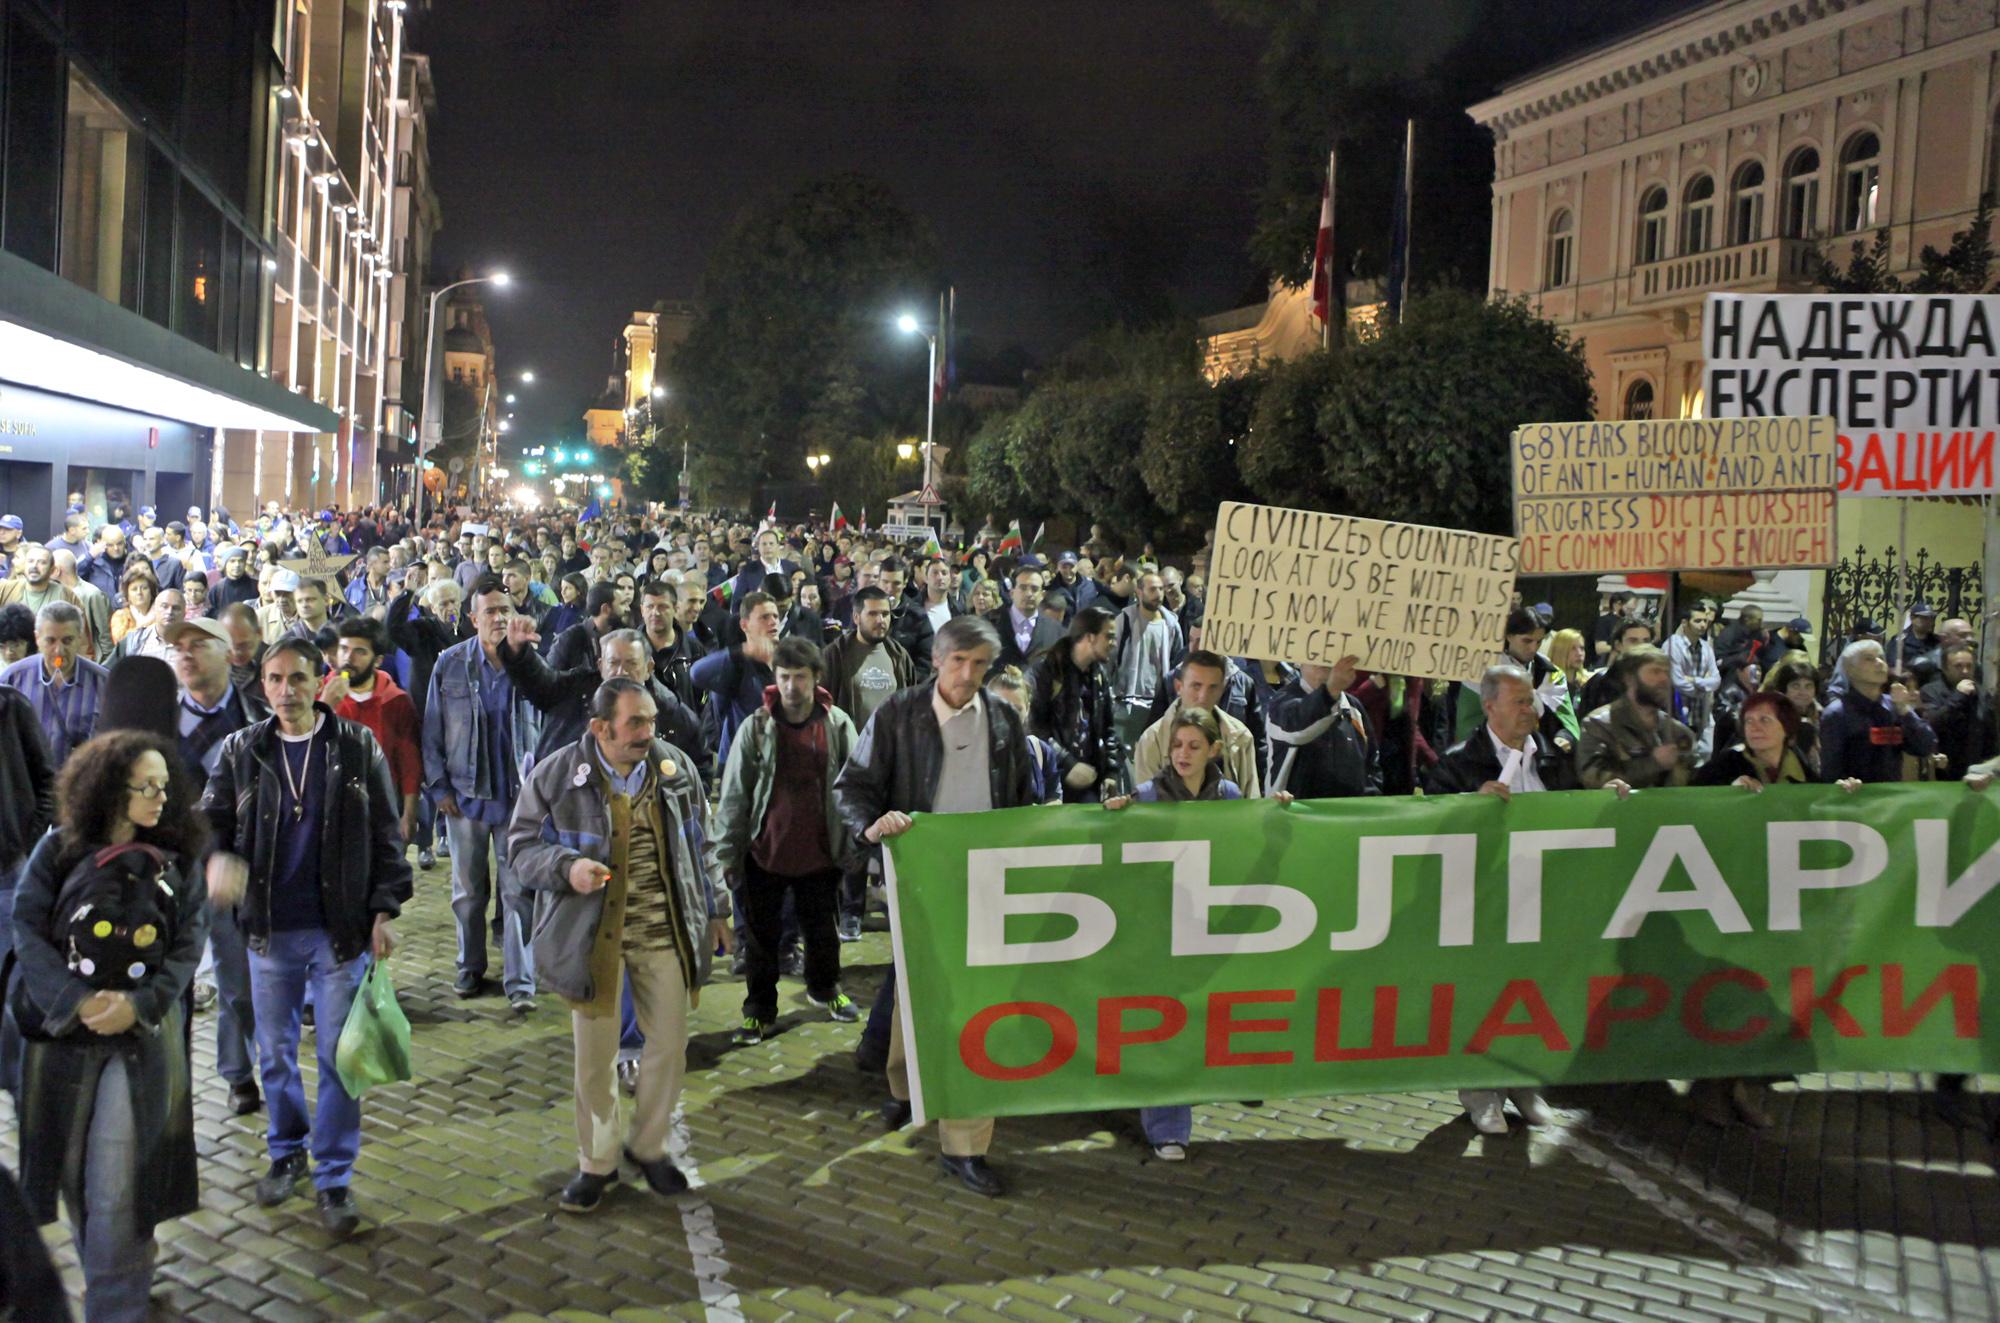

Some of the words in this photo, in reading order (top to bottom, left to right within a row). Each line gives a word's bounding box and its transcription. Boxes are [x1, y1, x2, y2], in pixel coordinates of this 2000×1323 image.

[1711, 298, 1996, 361] НАДЕЖДА
[1519, 424, 1554, 461] 68
[1558, 423, 1627, 459] YEARS
[1637, 420, 1724, 459] BLOODY
[1731, 417, 1824, 454] PROOF
[1522, 463, 1552, 494] OF
[1716, 455, 1764, 488] AND
[1771, 453, 1832, 486] ANTI
[1227, 505, 1371, 556] CIVILIZED
[1379, 523, 1519, 573] COUNTRIES
[1520, 497, 1640, 534] PROGRESS
[1649, 489, 1836, 529] DICTATORSHIP
[1218, 544, 1283, 583] LOOK
[1286, 552, 1319, 586] AT
[1328, 557, 1358, 591] US
[1367, 562, 1399, 596] BE
[1410, 568, 1464, 604] WITH
[1476, 577, 1511, 608] US
[1520, 534, 1552, 572] OF
[1556, 530, 1687, 571] COMMUNISM
[1699, 528, 1726, 567] IS
[1733, 527, 1829, 566] ENOUGH
[1213, 584, 1241, 617] IT
[1250, 588, 1278, 621] IS
[1286, 592, 1340, 628] NOW
[1356, 598, 1389, 631] WE
[1403, 603, 1460, 639] NEED
[1471, 609, 1505, 643] YOU
[1204, 618, 1255, 655] NOW
[1267, 626, 1297, 660] WE
[1305, 628, 1352, 664] GET
[1364, 634, 1416, 675] YOUR
[966, 818, 2000, 968] БЪЛГАРИ
[958, 963, 1981, 1082] ОРЕШАРСКИ
